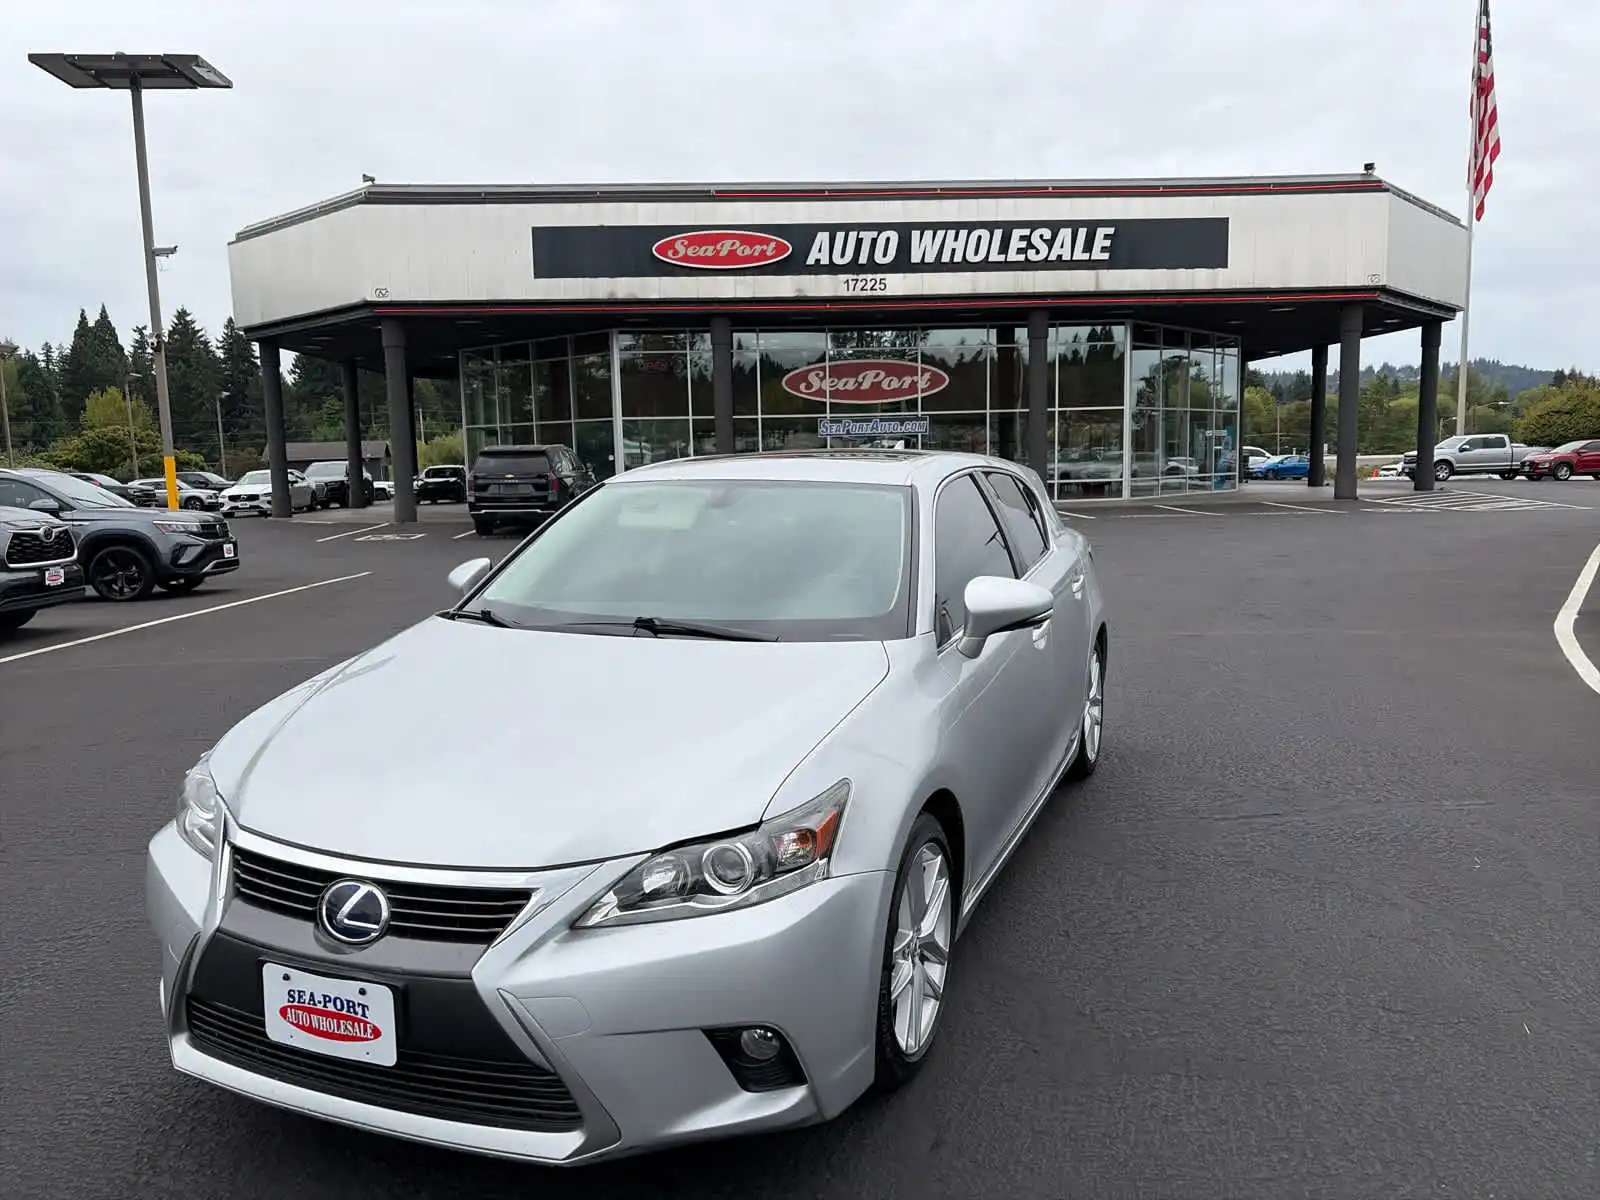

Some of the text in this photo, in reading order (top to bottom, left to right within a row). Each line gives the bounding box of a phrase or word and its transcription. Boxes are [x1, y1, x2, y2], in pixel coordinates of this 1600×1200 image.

[667, 227, 1115, 265] SeaPort AUTO WHOLESALE
[843, 278, 887, 292] 17225
[799, 369, 933, 393] SeaPort
[287, 989, 369, 1019] SEA-PORT
[285, 1007, 374, 1038] AUTO WHOLESALE
